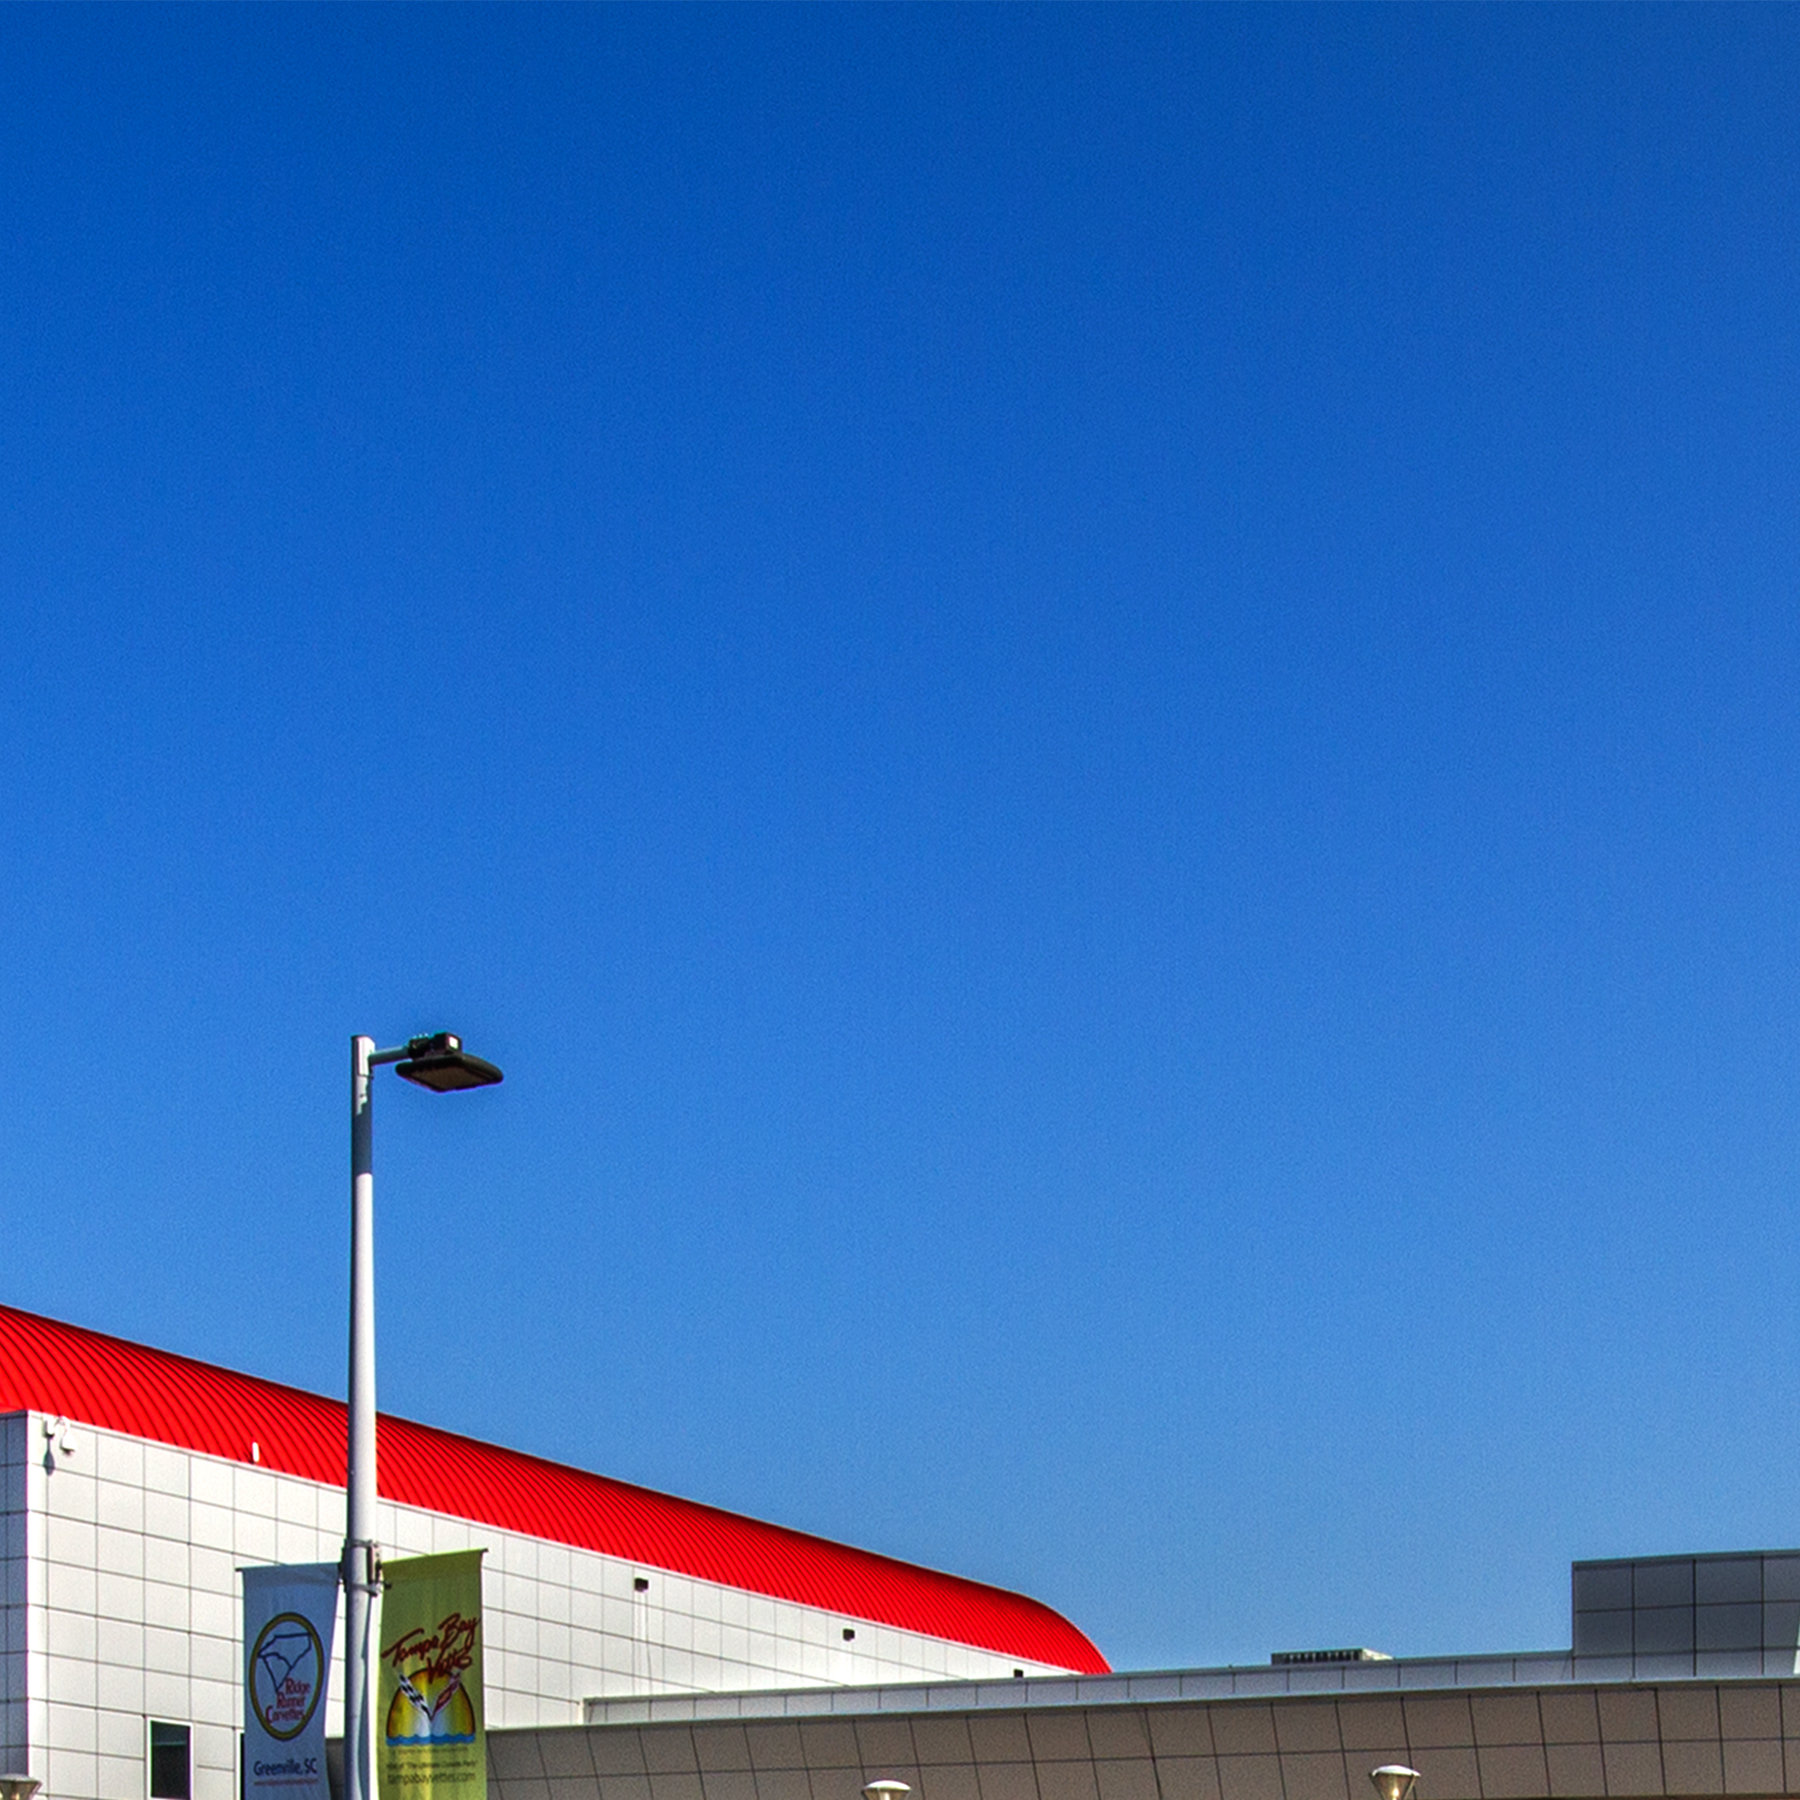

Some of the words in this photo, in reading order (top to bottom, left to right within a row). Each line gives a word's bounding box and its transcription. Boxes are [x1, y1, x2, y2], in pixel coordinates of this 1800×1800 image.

[381, 1627, 440, 1668] Tampa
[438, 1612, 482, 1652] Bay
[285, 1677, 311, 1695] Ridge
[265, 1705, 306, 1725] Corvettes
[304, 1757, 318, 1774] SC
